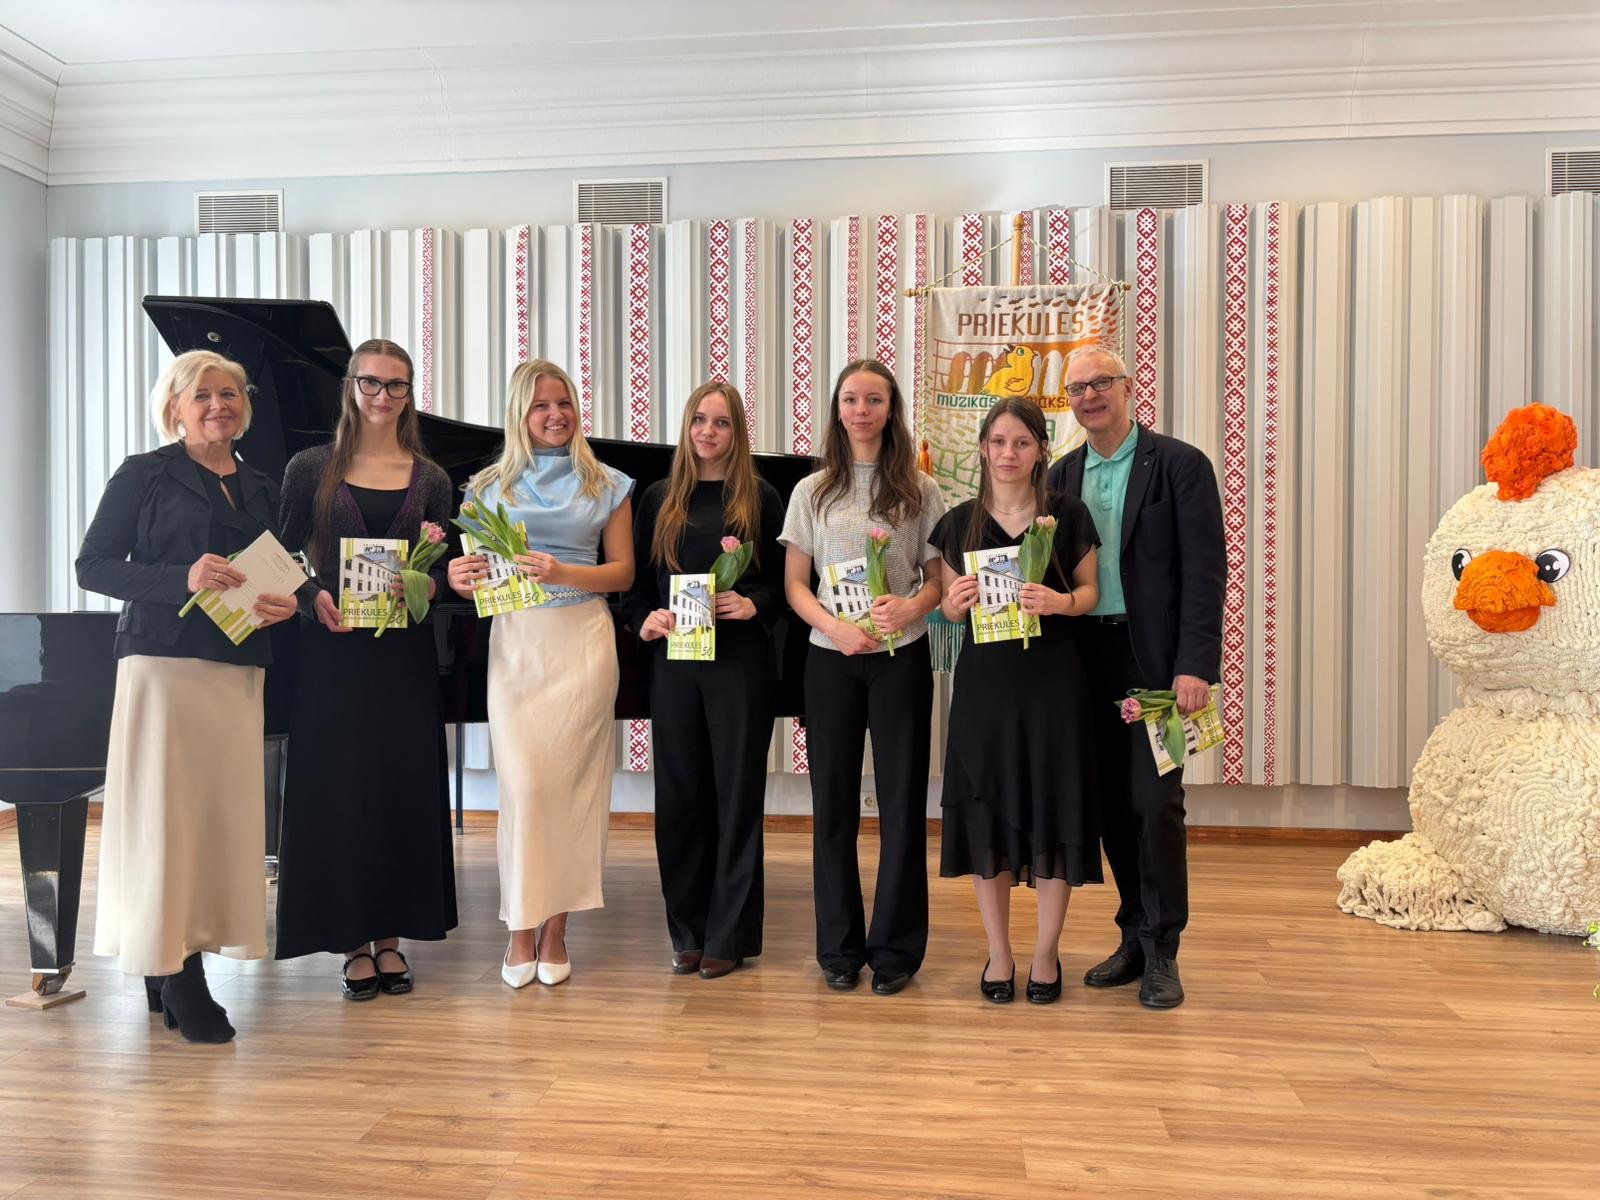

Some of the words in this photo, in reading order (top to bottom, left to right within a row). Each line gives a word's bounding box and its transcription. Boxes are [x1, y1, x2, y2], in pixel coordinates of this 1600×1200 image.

[957, 311, 1084, 337] PRIEKULES
[479, 591, 522, 605] PRIEKULES
[524, 591, 540, 605] 50
[343, 608, 388, 617] PRIEKULES
[976, 618, 1020, 631] PRIEKULES
[671, 641, 702, 649] PRIEKULES
[701, 646, 713, 657] 50
